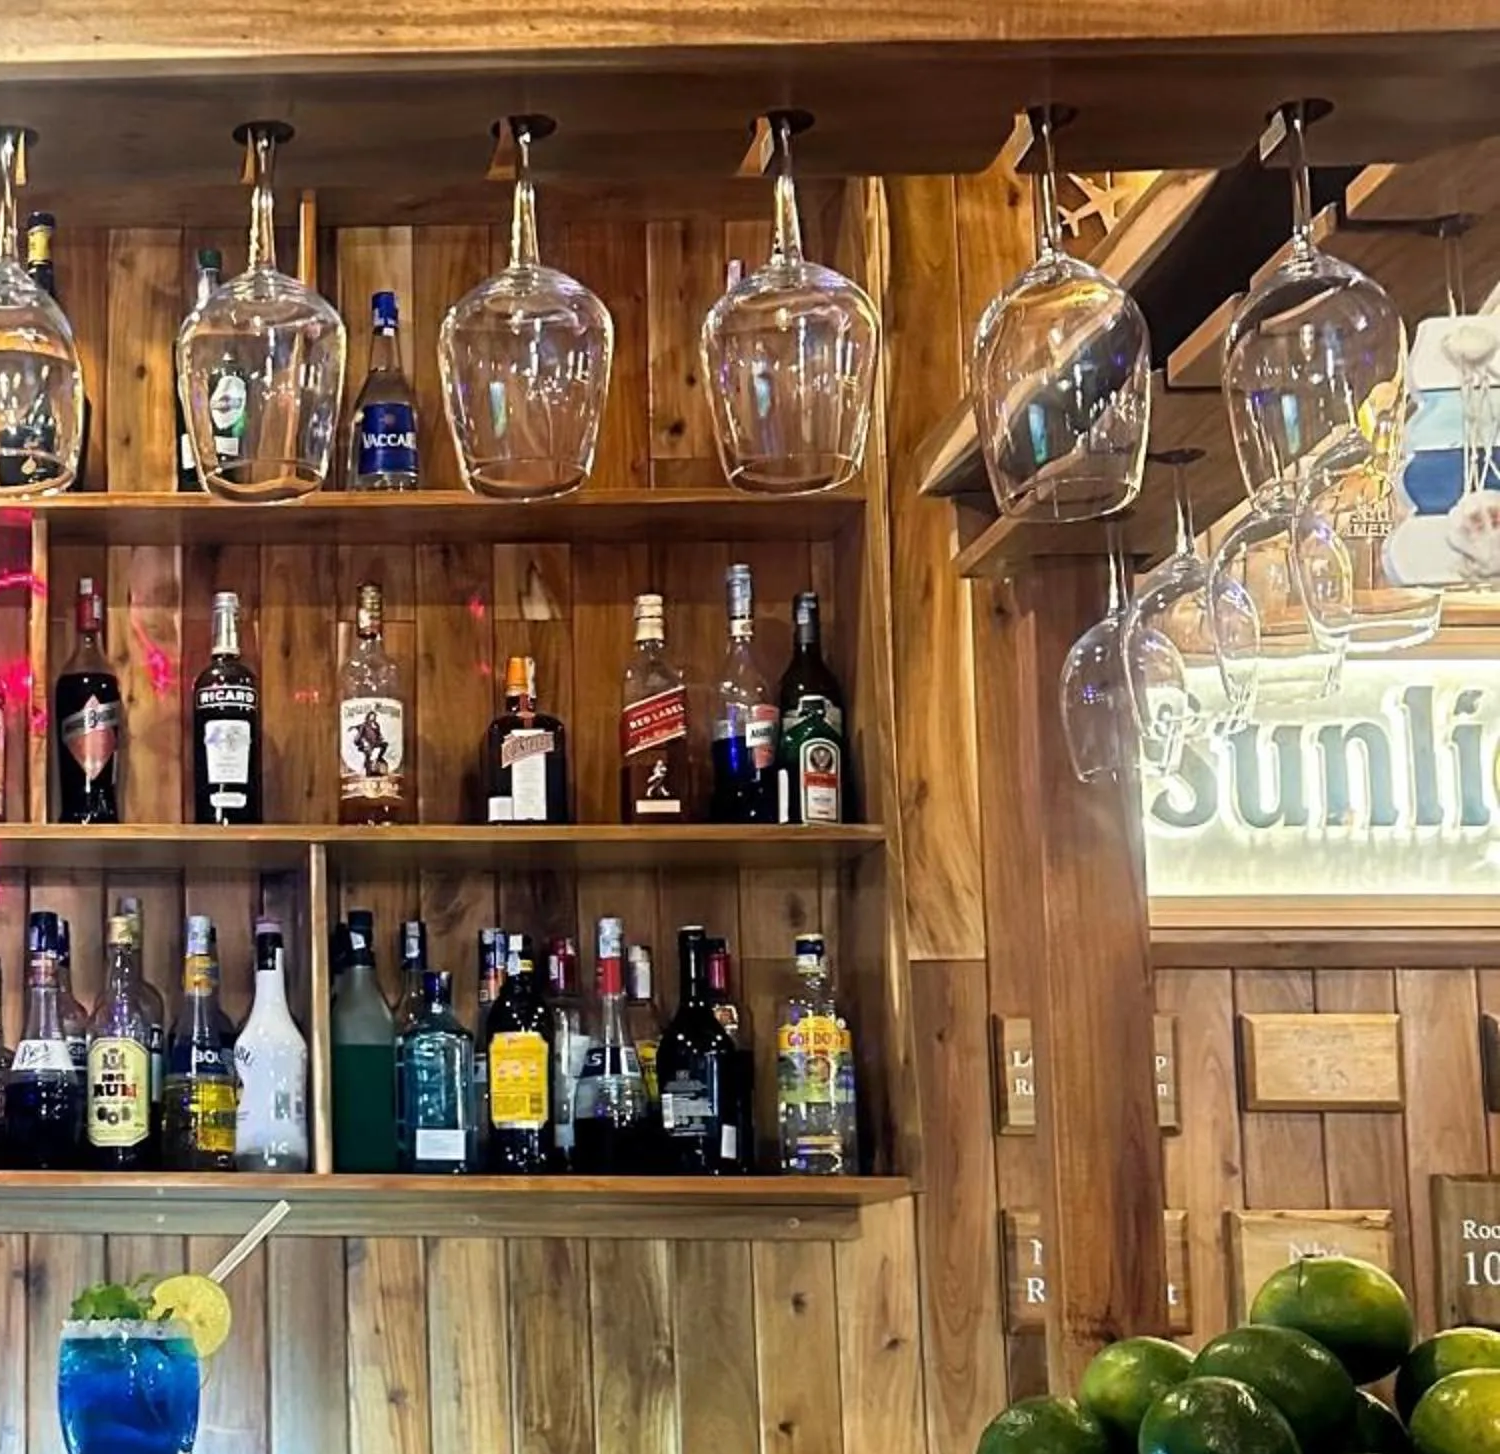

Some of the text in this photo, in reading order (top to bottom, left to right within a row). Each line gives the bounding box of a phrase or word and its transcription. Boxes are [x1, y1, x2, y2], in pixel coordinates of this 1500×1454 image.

[200, 690, 255, 704] RICARD
[629, 703, 685, 730] RED LABEL
[1142, 685, 1500, 831] Sunli
[93, 1083, 137, 1098] RUM
